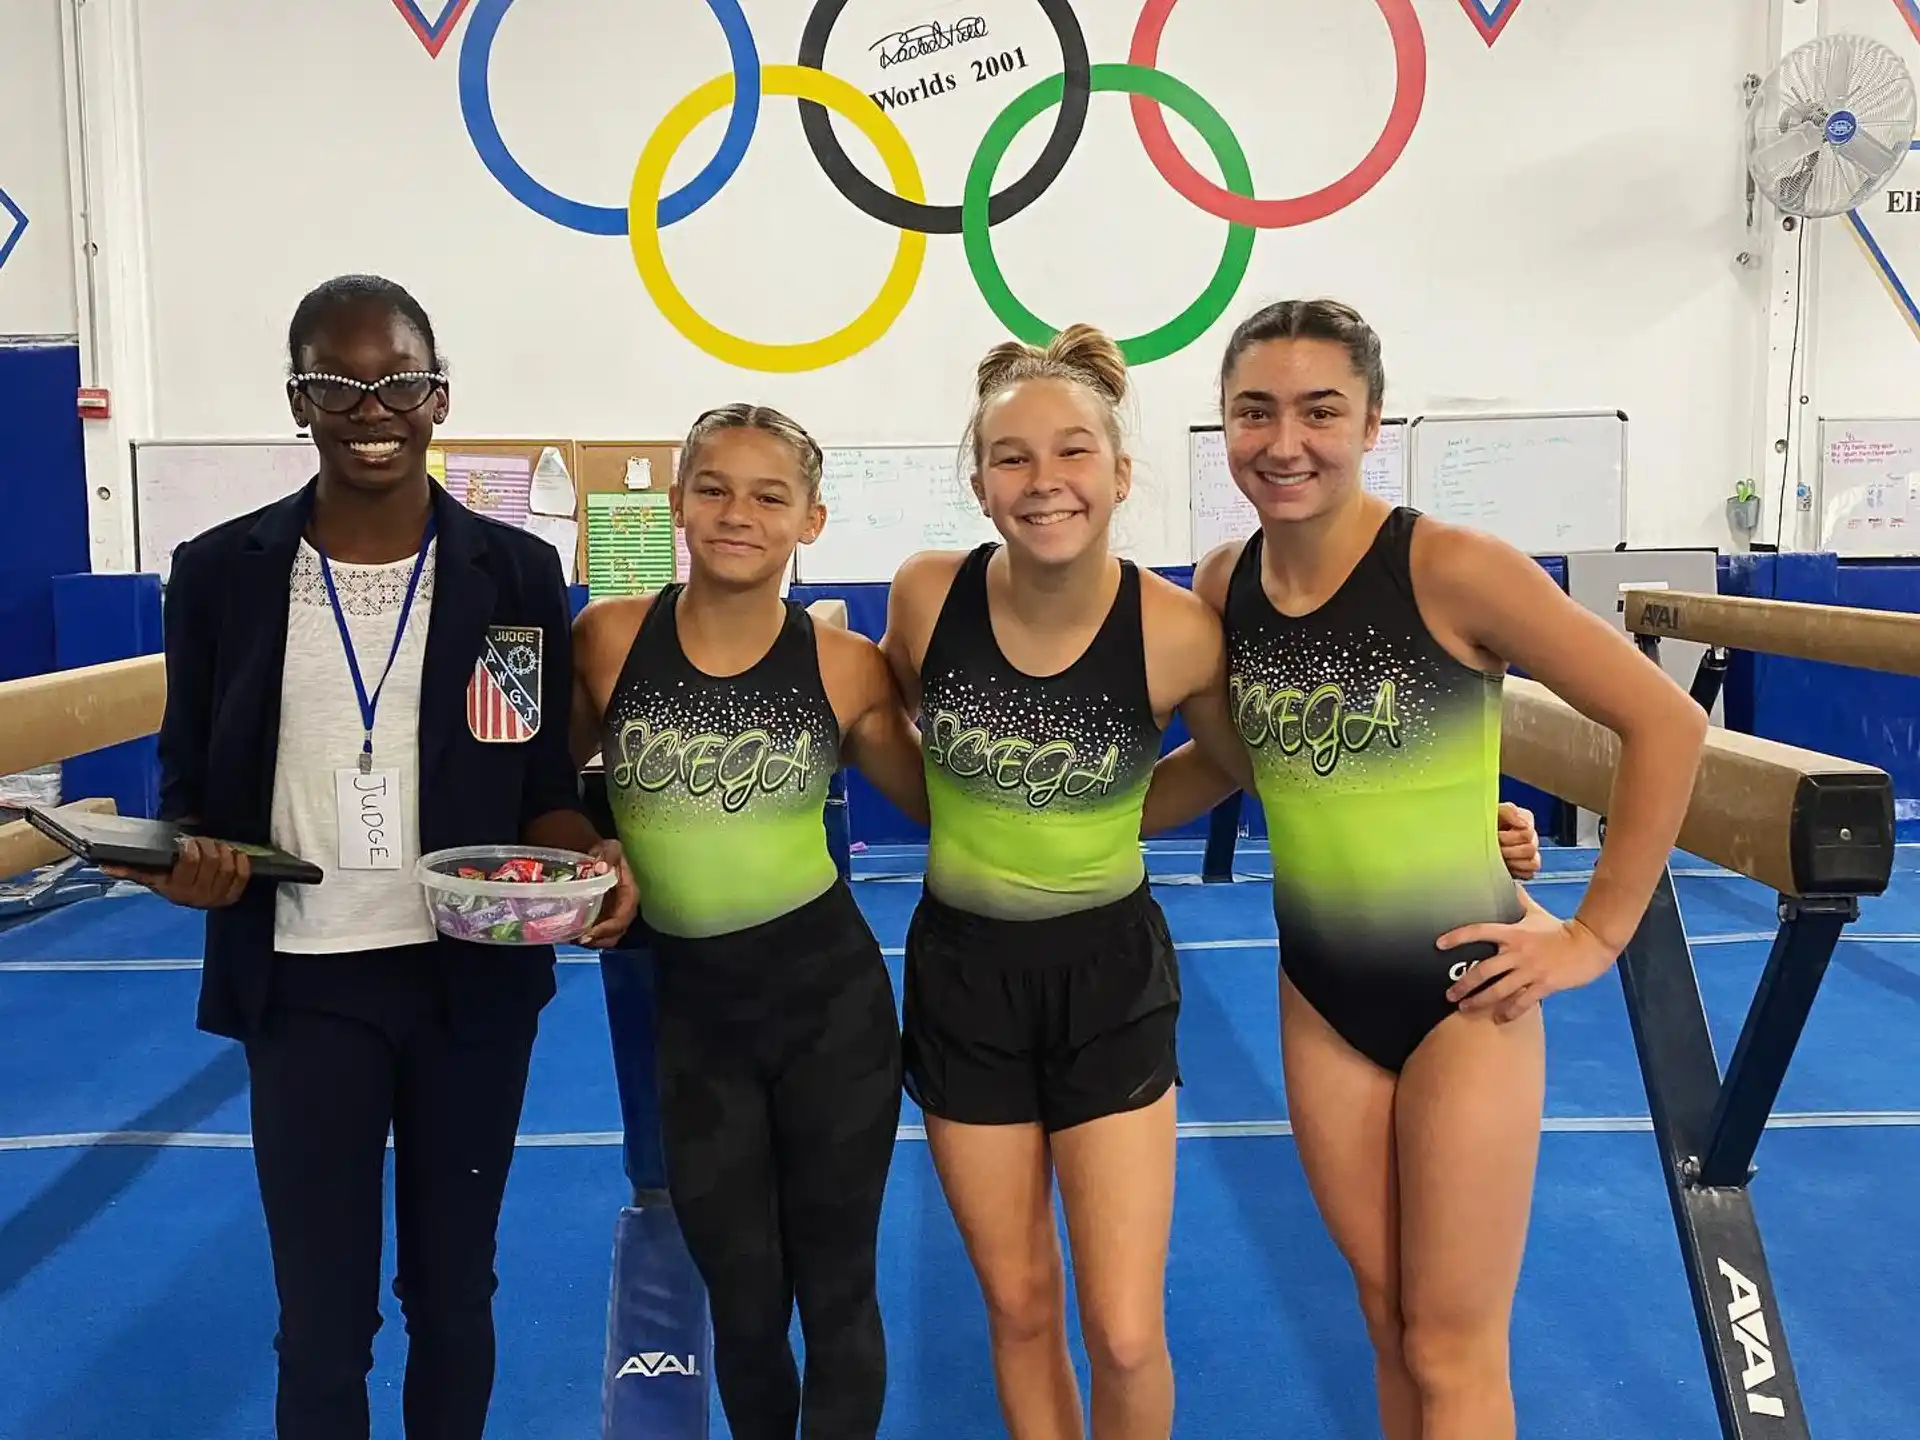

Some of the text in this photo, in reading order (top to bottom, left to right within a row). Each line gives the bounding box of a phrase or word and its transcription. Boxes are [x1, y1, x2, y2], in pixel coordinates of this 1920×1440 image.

[869, 46, 1028, 112] Worlds 2001
[495, 631, 534, 643] JUDGE
[613, 718, 811, 813] SCEGA
[929, 710, 1119, 808] SCEGA
